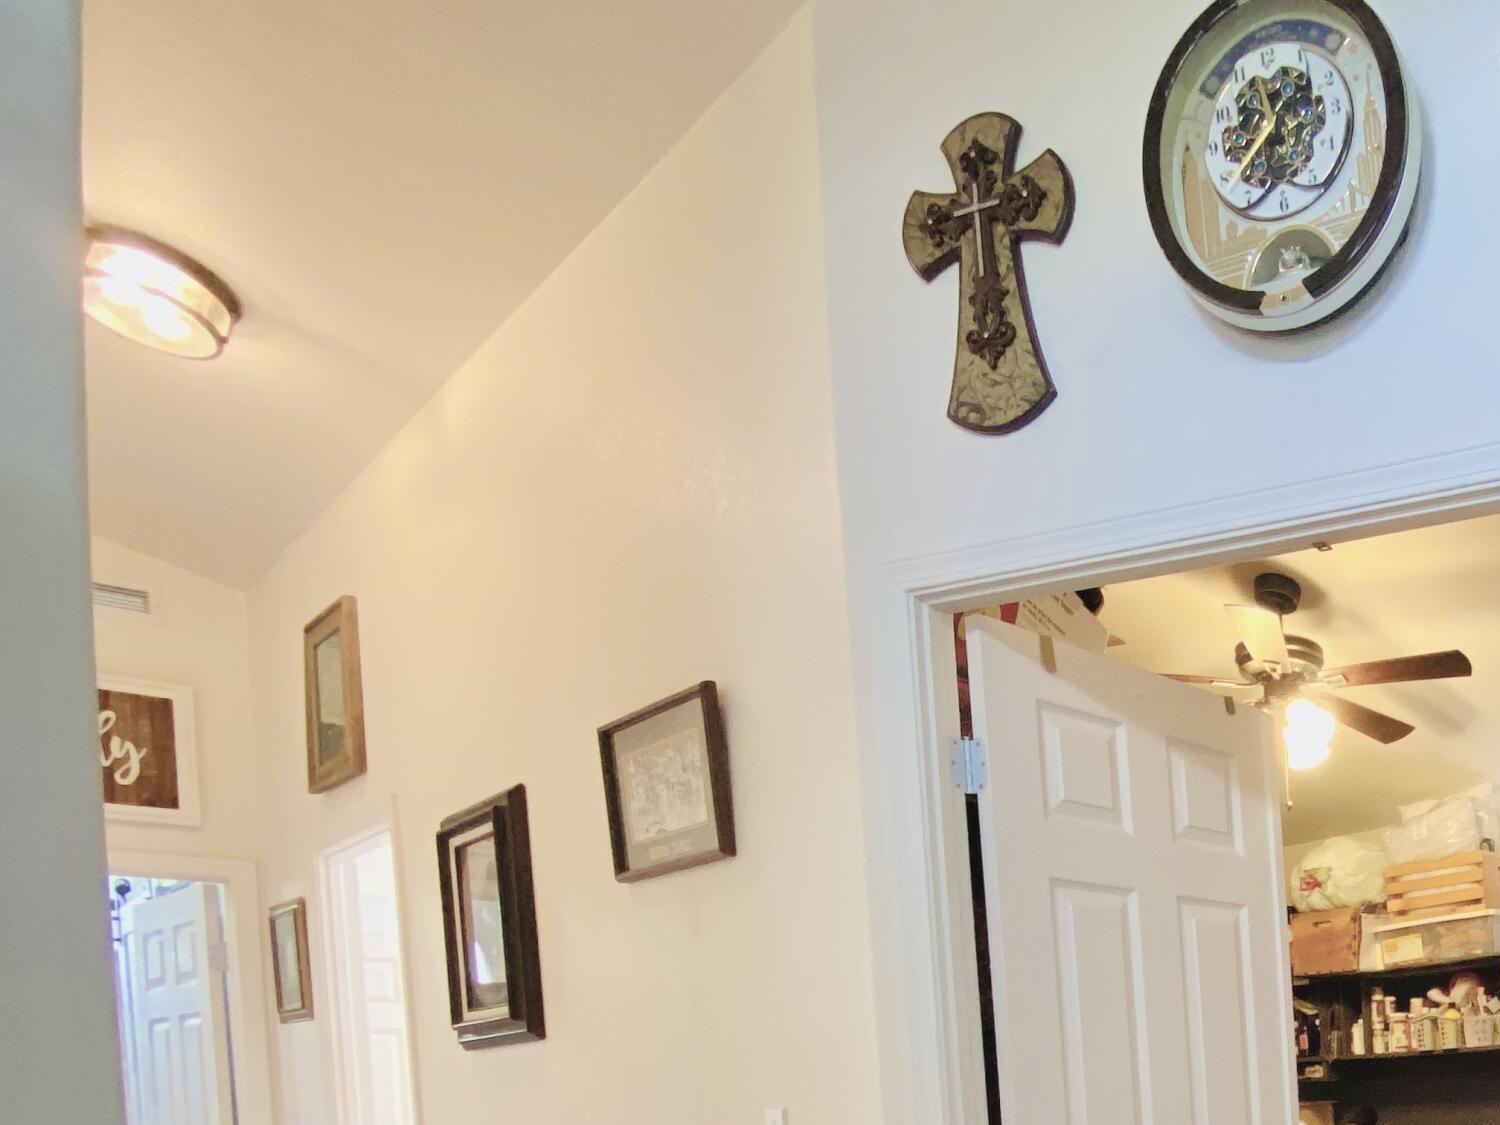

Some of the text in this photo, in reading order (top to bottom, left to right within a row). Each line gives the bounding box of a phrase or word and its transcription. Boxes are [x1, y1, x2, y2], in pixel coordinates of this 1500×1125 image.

[1260, 47, 1276, 66] 12
[1234, 66, 1246, 83] 11
[1324, 69, 1334, 86] 2
[1216, 106, 1230, 124] 10
[1331, 98, 1342, 115] 3
[1208, 142, 1218, 156] 9
[1279, 197, 1290, 213] 6
